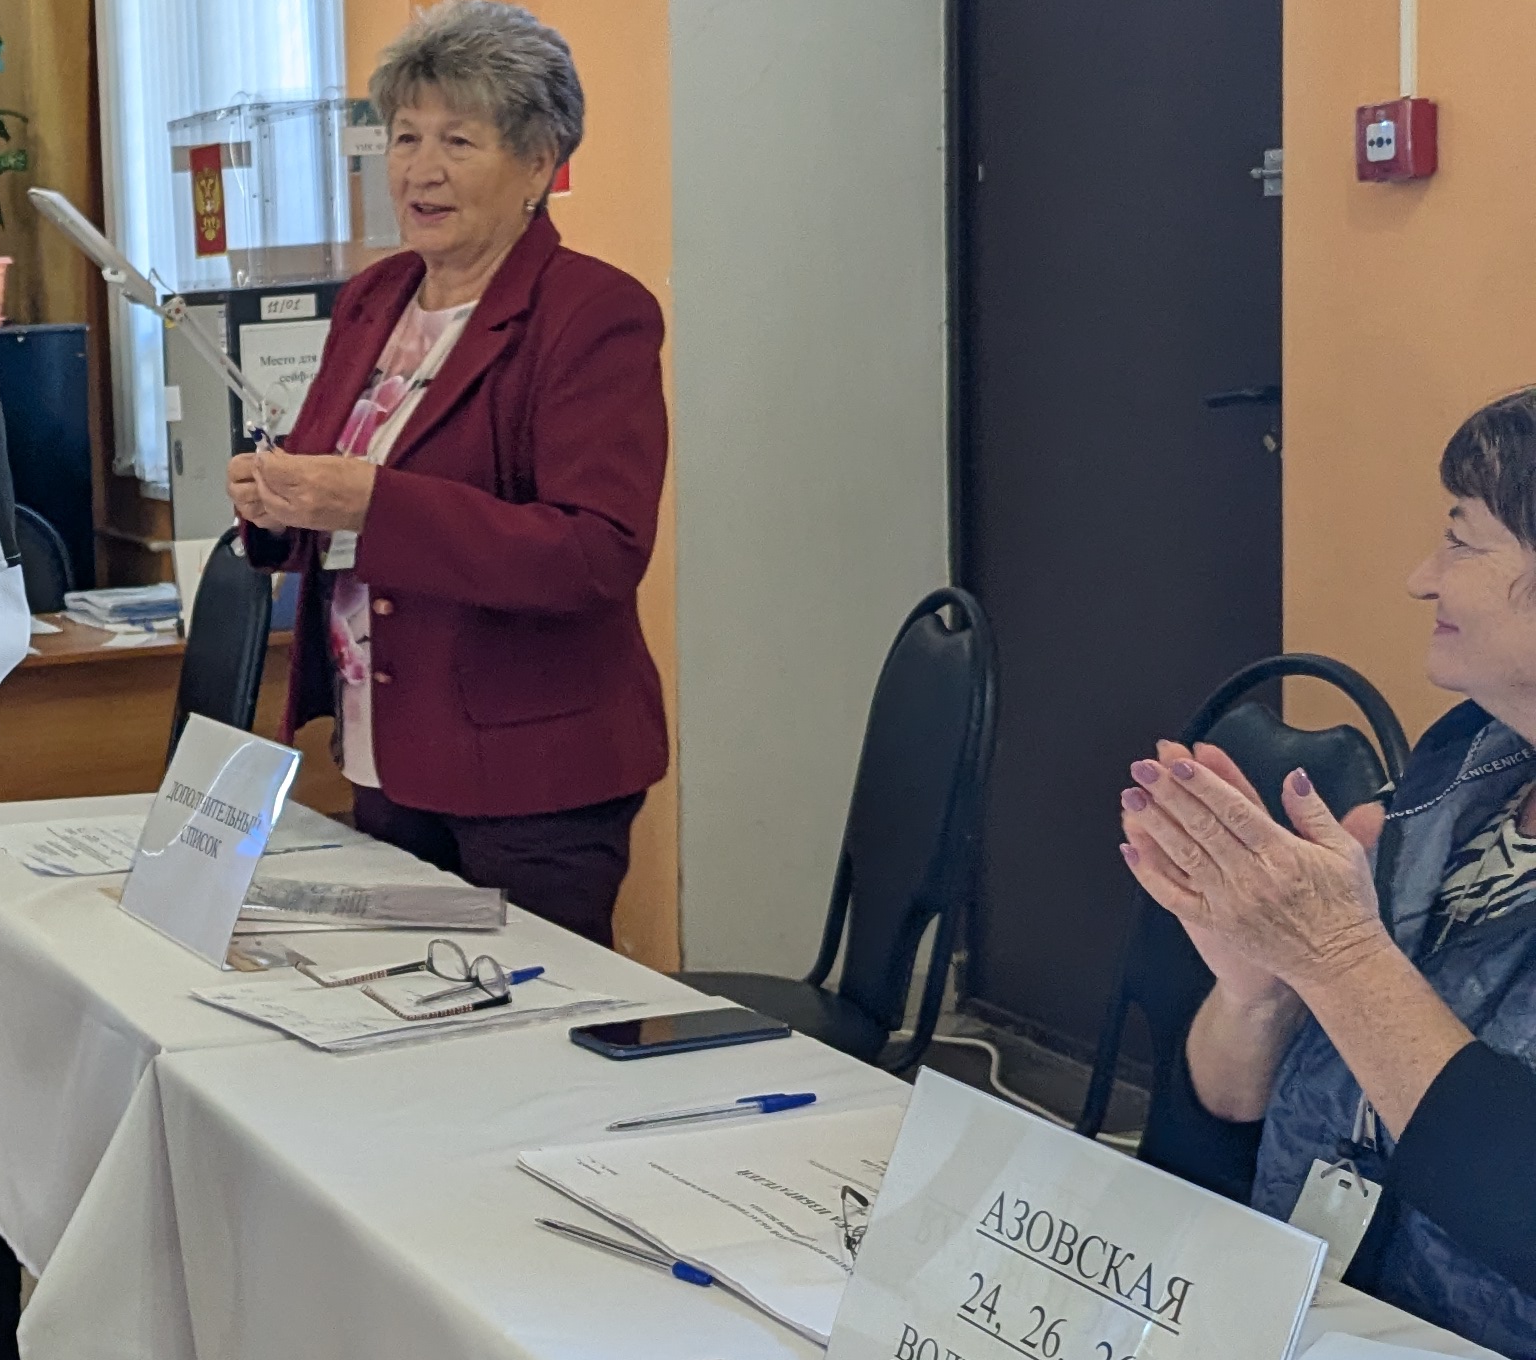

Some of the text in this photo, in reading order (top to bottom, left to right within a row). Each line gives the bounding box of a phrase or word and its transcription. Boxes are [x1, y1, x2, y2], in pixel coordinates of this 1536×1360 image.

[267, 298, 301, 313] 11/01
[260, 355, 317, 366] Место для
[180, 825, 222, 859] СПИСОК
[978, 1190, 1195, 1326] АЗОВСКАЯ
[960, 1273, 1003, 1331] 24,
